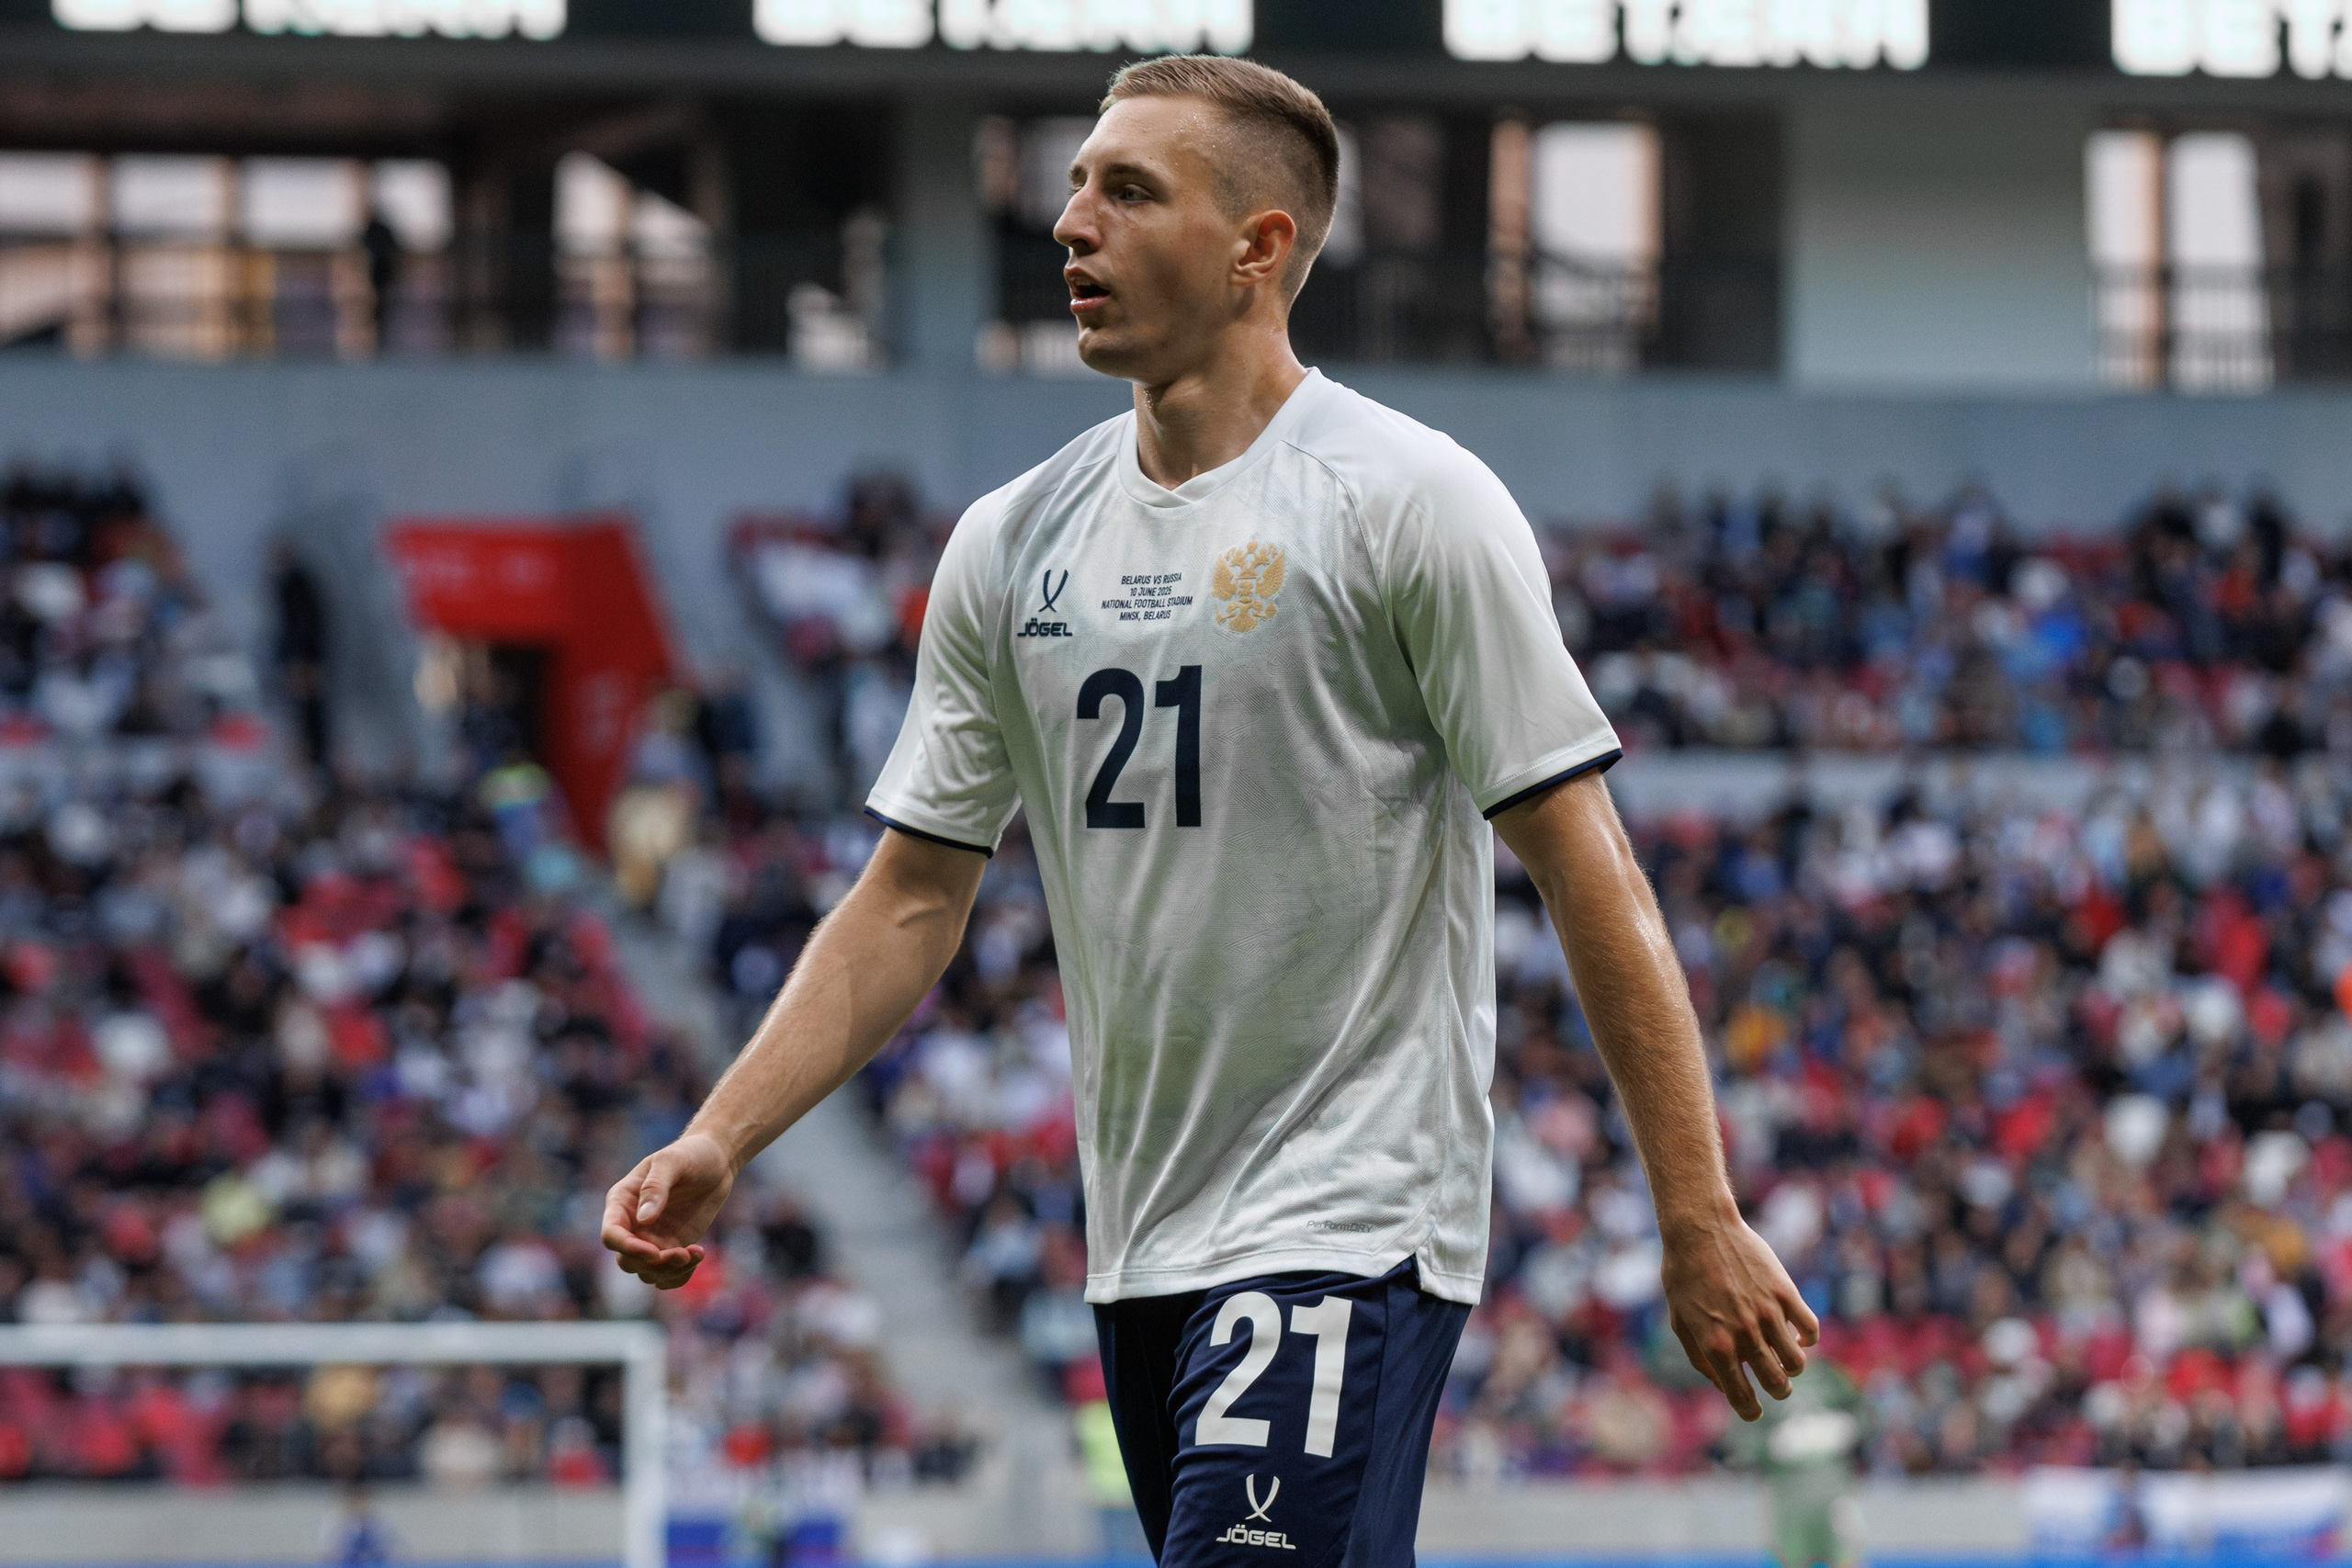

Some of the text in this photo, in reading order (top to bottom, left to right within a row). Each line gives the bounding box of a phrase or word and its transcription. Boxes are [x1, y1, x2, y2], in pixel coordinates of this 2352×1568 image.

[1121, 572, 1182, 584] BELARUS VS RUSSIA
[1130, 586, 1172, 597] 10 JUNE 2025
[1101, 596, 1193, 609] NATIONAL FOOTBALL STADIUM
[1119, 610, 1171, 621] MINSK, BELARUS
[1016, 617, 1073, 637] JÖGEL
[1076, 664, 1203, 829] 21
[1194, 1291, 1352, 1459] 21
[1216, 1523, 1297, 1550] JÖGEL
